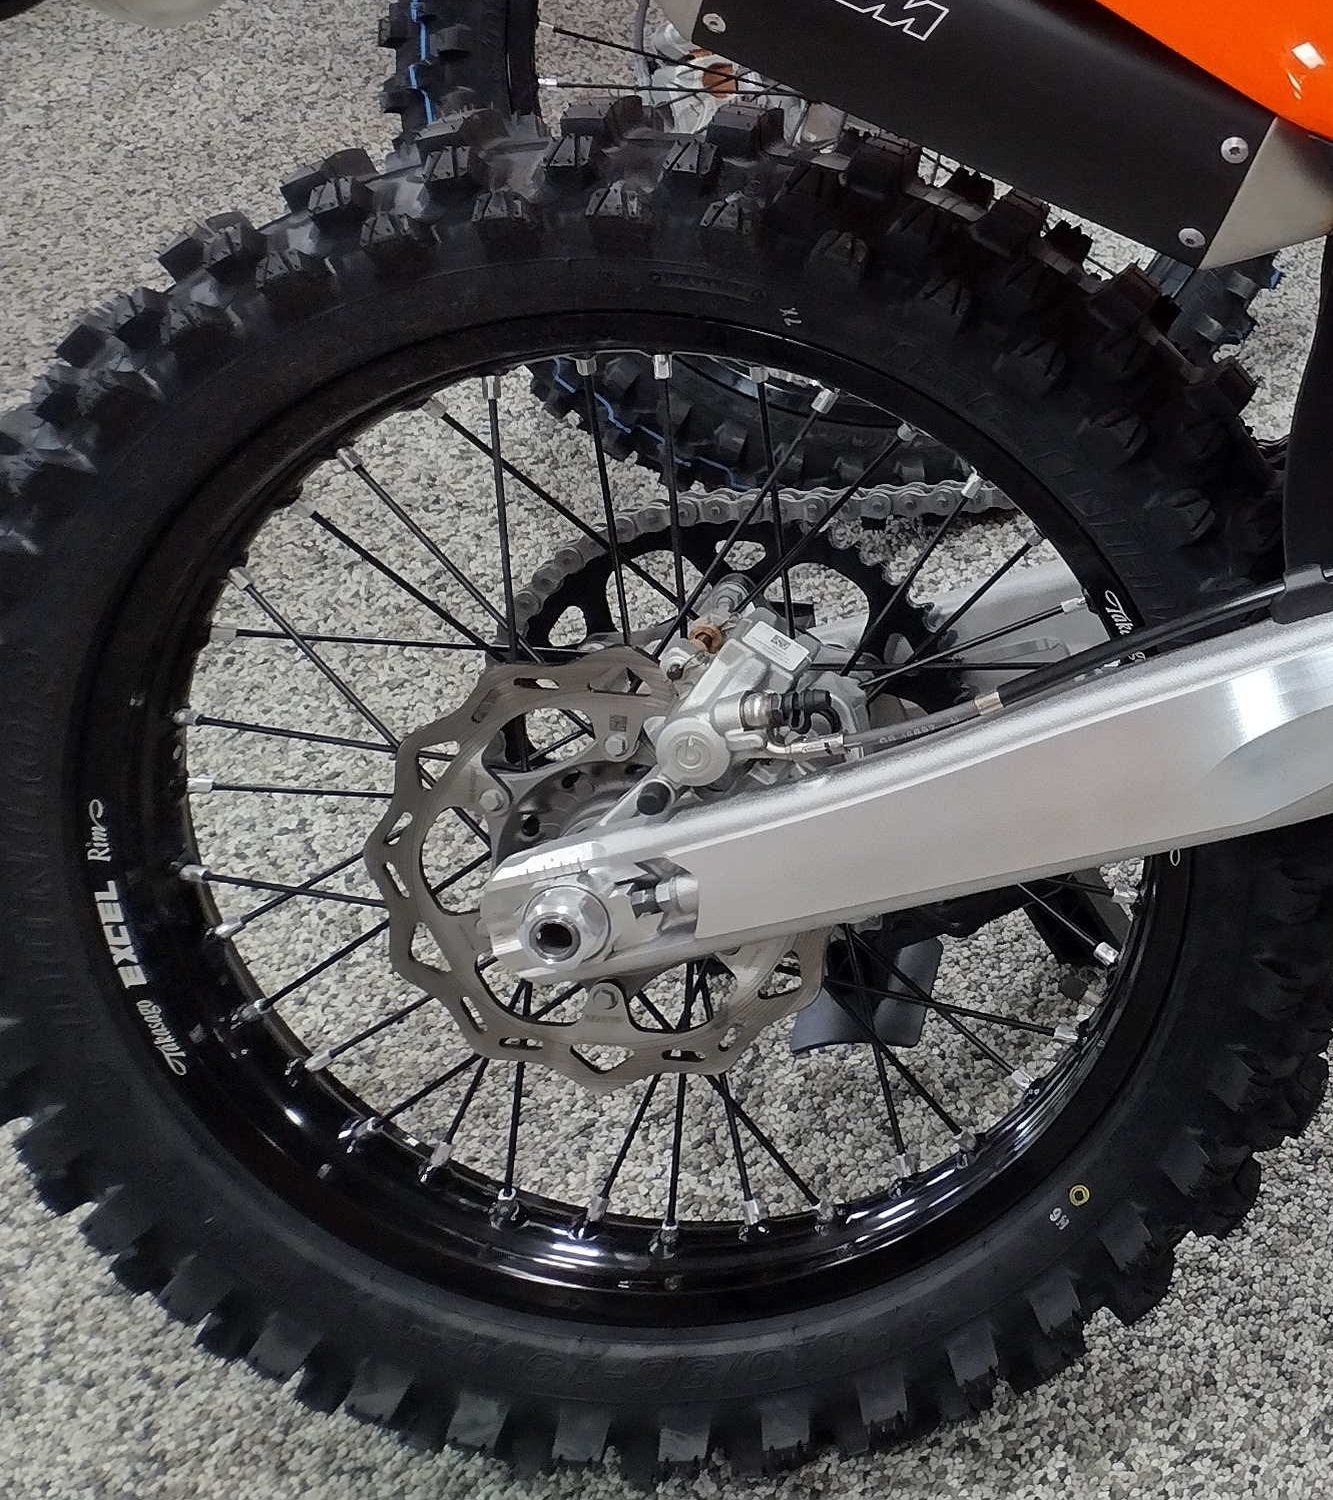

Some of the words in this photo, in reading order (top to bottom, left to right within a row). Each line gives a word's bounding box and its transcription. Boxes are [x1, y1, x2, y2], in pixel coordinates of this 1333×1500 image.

[86, 798, 112, 863] Rim
[94, 880, 147, 990] EXCEL
[136, 999, 187, 1077] Takasago
